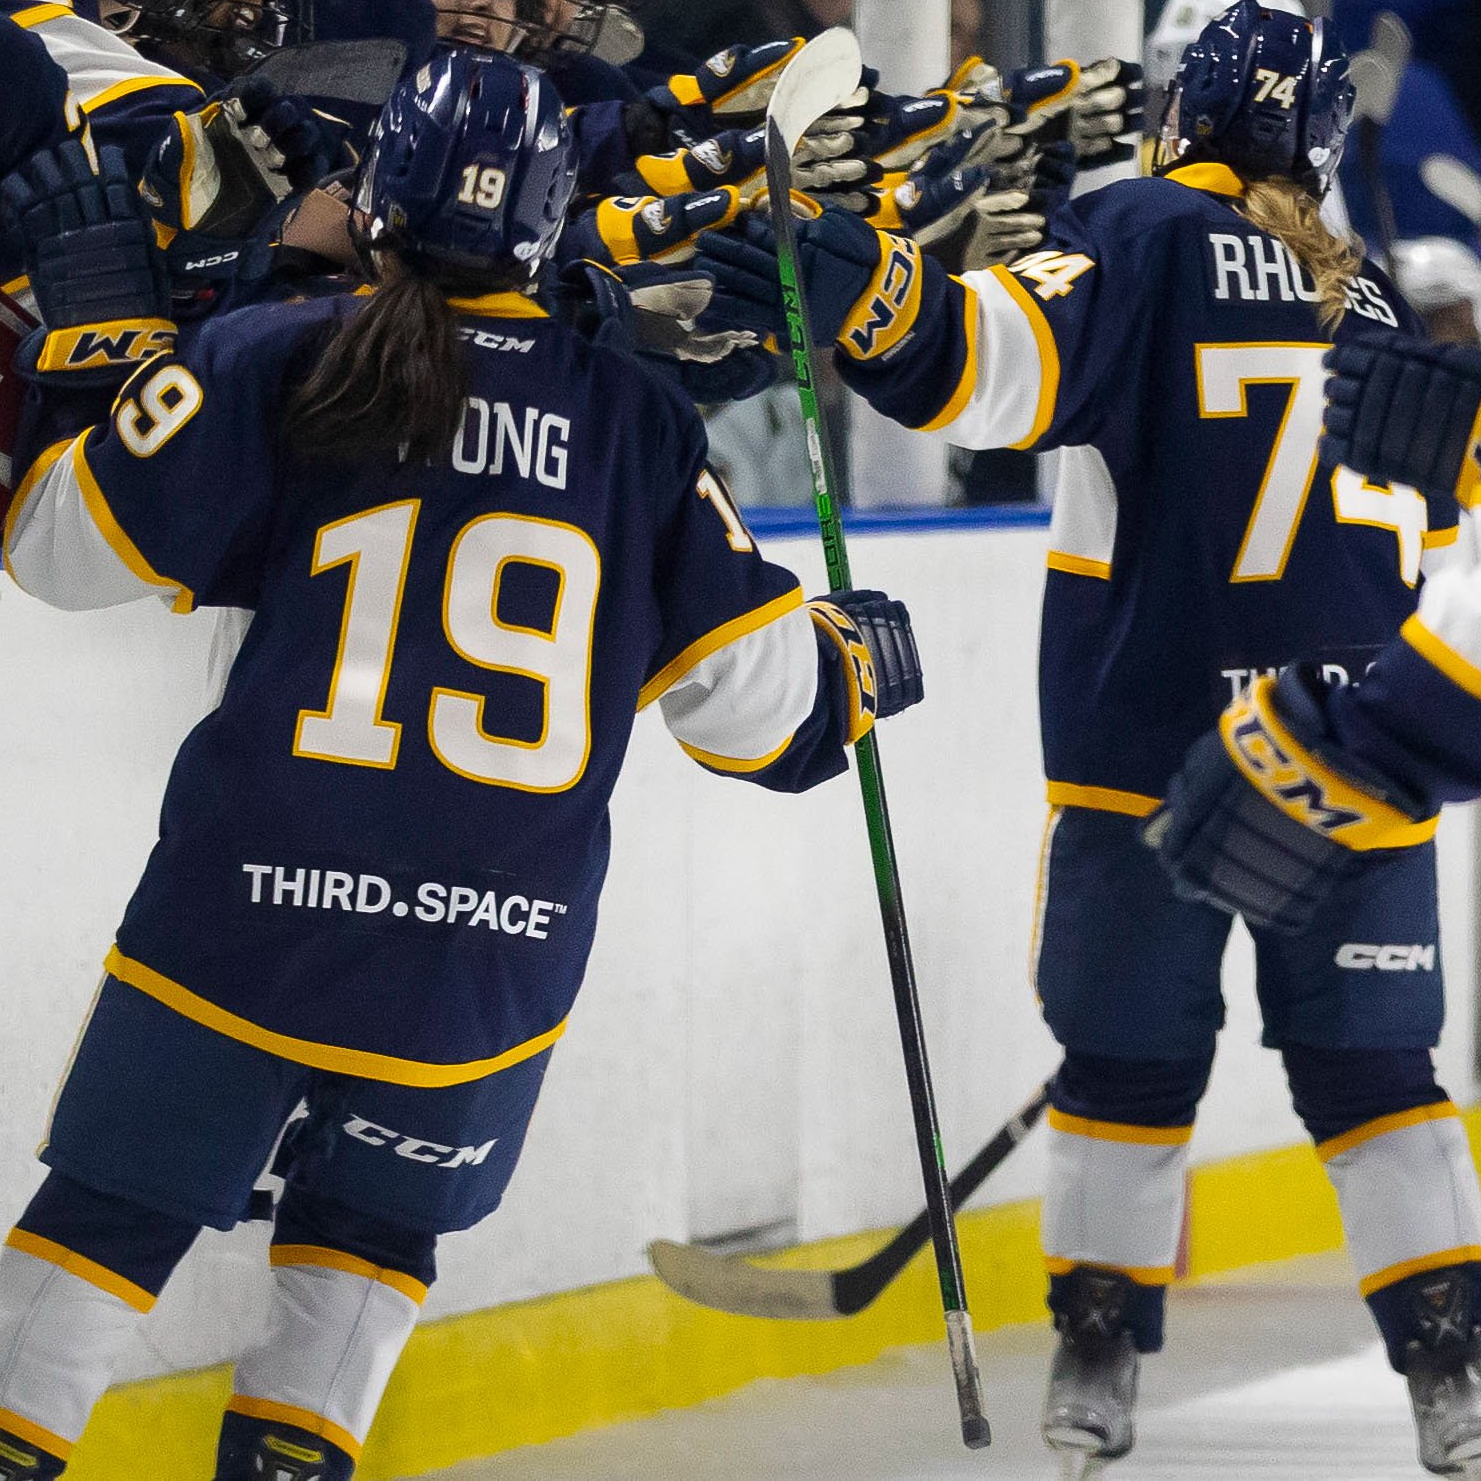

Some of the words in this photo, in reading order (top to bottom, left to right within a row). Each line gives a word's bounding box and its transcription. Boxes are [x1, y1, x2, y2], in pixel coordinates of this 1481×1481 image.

[1252, 67, 1298, 108] 74
[458, 160, 507, 209] 19
[185, 250, 239, 271] CCM
[1208, 231, 1399, 327] RHOES
[112, 351, 205, 459] 9
[399, 398, 572, 492] ONG
[291, 497, 602, 795] 19
[1235, 718, 1366, 831] CM
[1334, 942, 1435, 972] CCM
[342, 1113, 502, 1169] CCM
